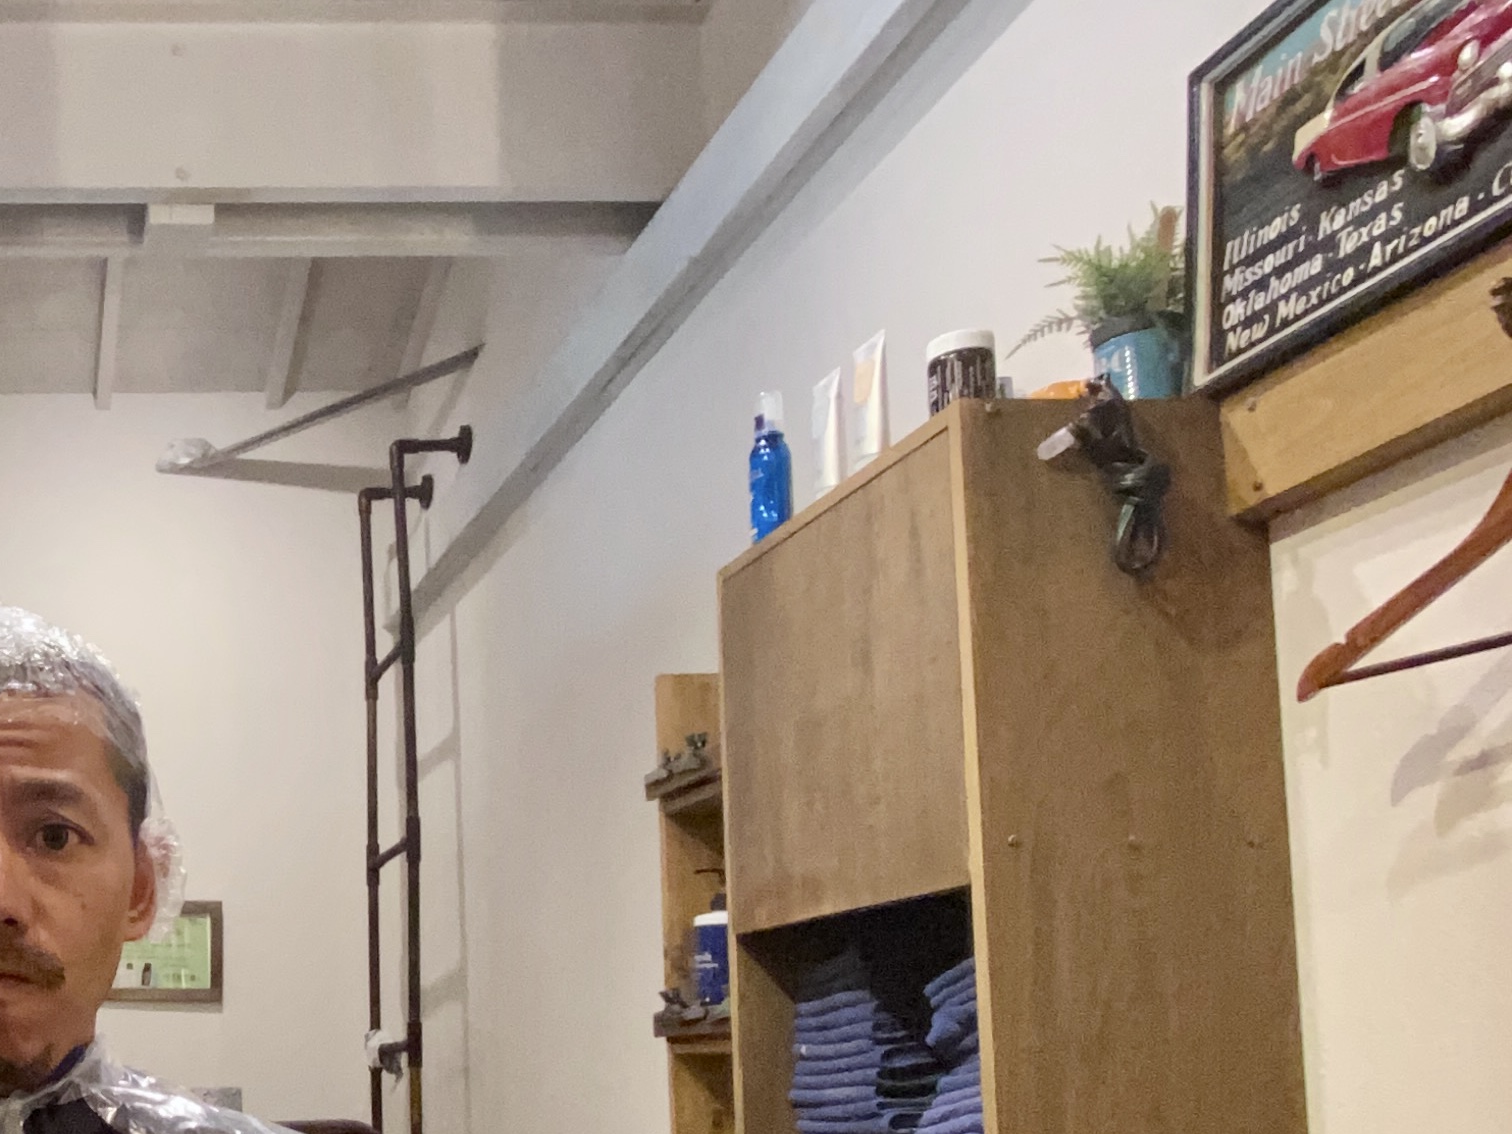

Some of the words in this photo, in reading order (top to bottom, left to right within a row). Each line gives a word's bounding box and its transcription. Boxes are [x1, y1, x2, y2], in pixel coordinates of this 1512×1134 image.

[1226, 51, 1304, 136] Main
[1220, 226, 1307, 303] Missouri
[1316, 169, 1405, 241] Kansas
[1222, 253, 1323, 330] Oklahoma
[1336, 202, 1404, 259] Texas
[1223, 203, 1301, 271] Illinois
[1224, 314, 1270, 358] New
[1275, 266, 1355, 328] Mexico
[1367, 195, 1470, 273] Arizona
